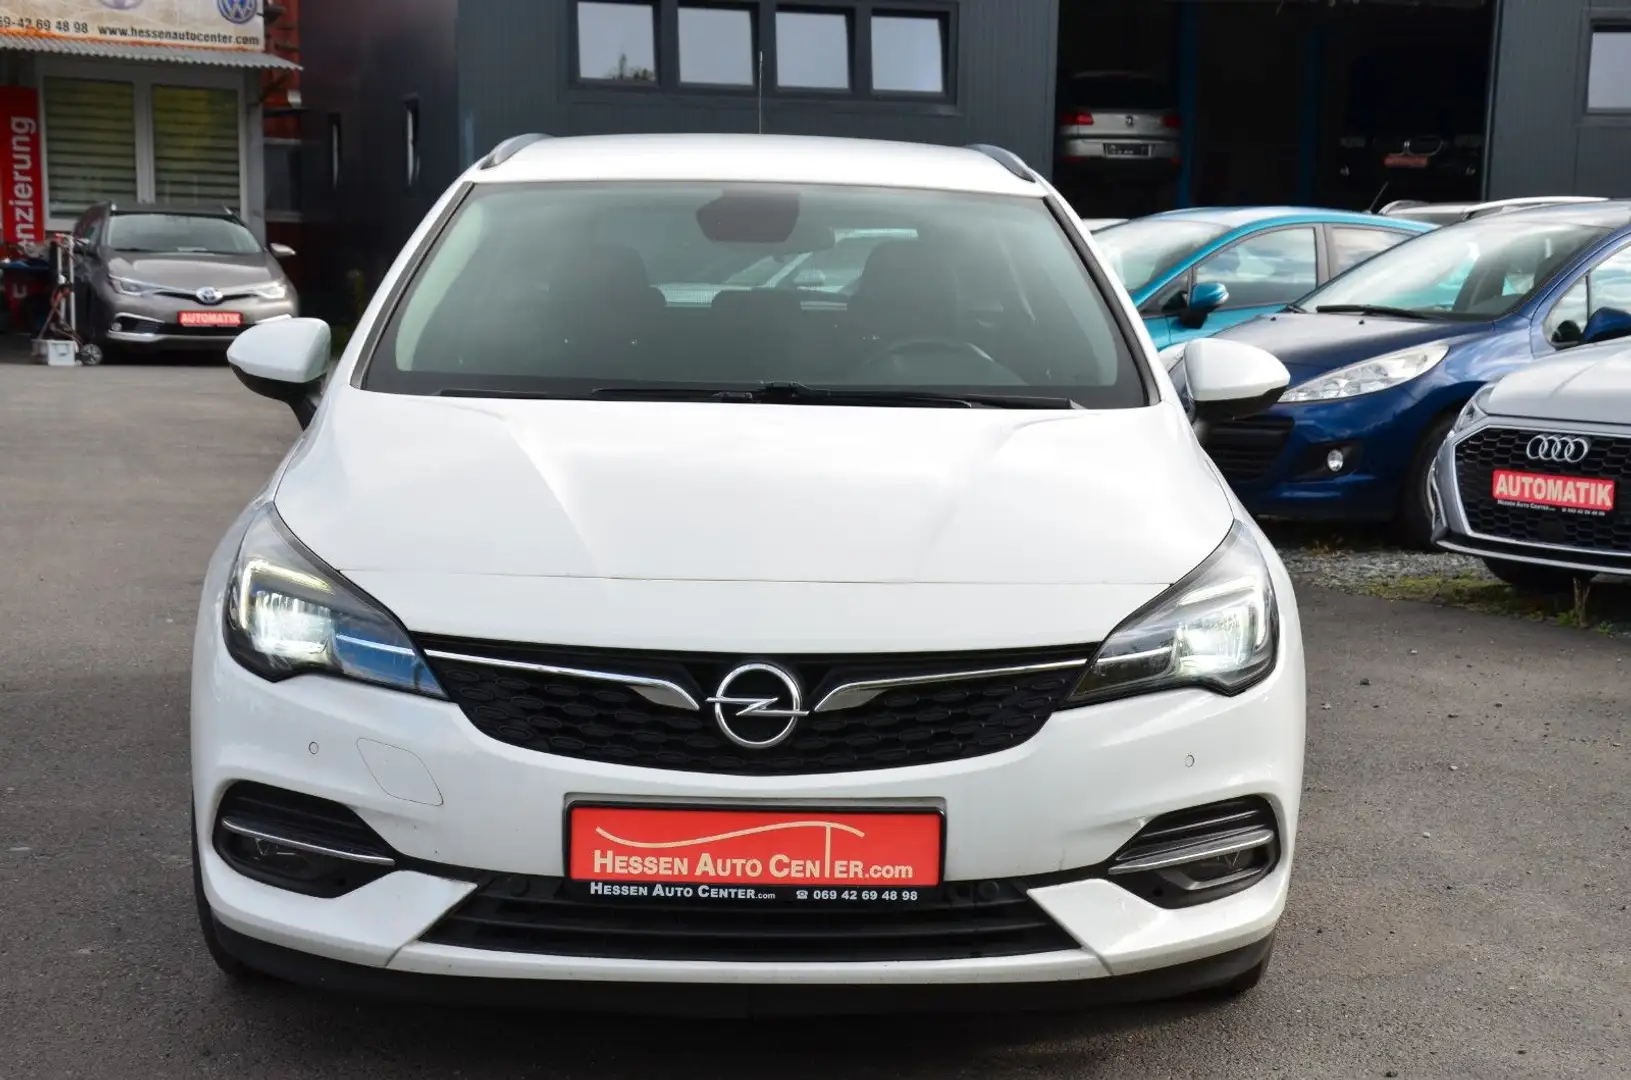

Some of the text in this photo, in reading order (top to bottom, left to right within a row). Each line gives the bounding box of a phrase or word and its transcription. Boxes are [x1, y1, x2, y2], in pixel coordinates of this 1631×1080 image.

[36, 18, 51, 31] 69
[56, 20, 70, 32] 48
[74, 21, 89, 33] 98
[97, 24, 260, 46] www.hessenautocenter.com
[180, 312, 241, 324] AUTOMATIK
[1496, 474, 1613, 507] AUTOMATIK
[593, 849, 689, 875] HESSEN
[694, 852, 763, 877] AUTO
[590, 882, 918, 901] HESSEN AUTO CENTER.com 069 42 69 48 98
